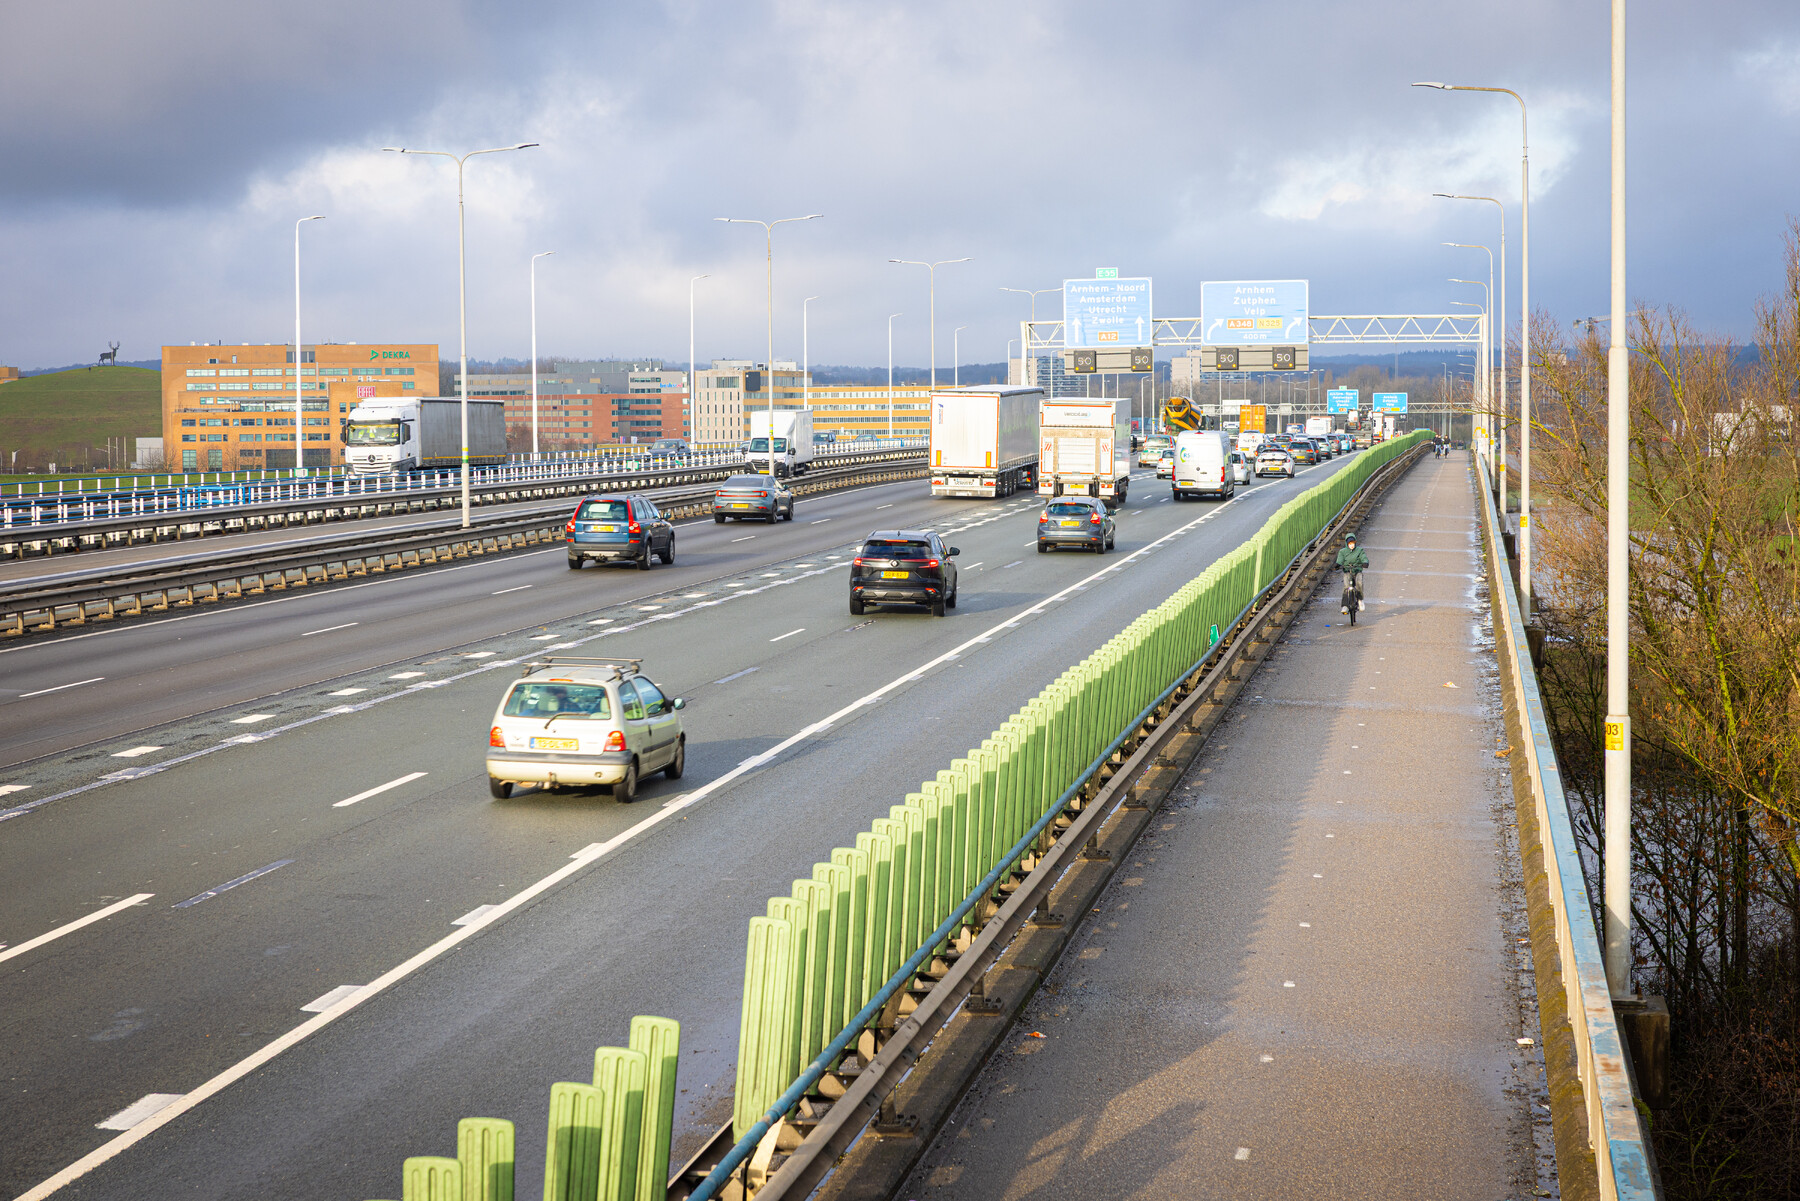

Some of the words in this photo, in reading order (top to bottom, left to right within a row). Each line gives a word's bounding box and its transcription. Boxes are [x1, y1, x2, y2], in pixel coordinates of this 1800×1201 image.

[1235, 286, 1274, 294] Arnhem
[1080, 295, 1136, 304] Amsterdam
[1233, 297, 1276, 306] Zutphen
[1088, 305, 1127, 314] Utrecht
[1244, 307, 1266, 316] Velp
[1092, 315, 1124, 324] Zwolle
[382, 351, 410, 359] DEKRA
[1135, 355, 1149, 364] 50
[1220, 353, 1234, 363] 50
[1276, 353, 1291, 362] 50
[1077, 356, 1092, 365] 50
